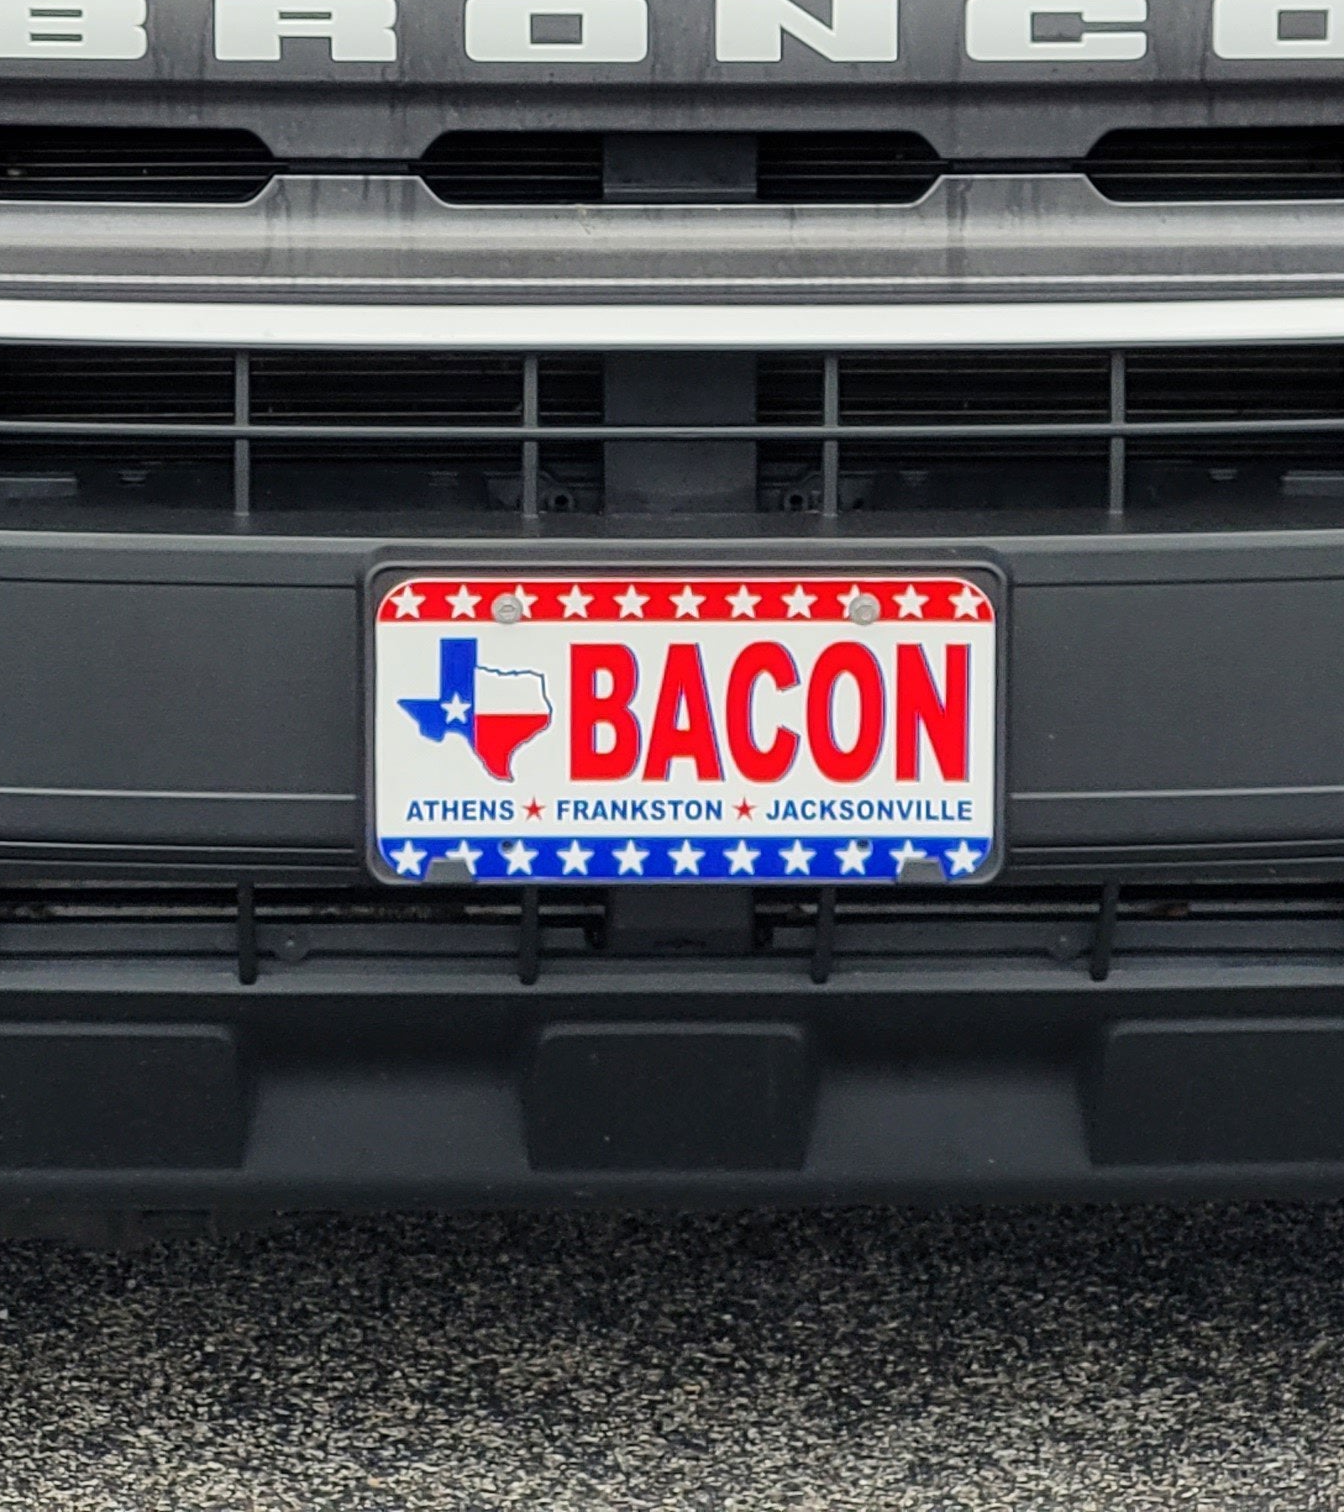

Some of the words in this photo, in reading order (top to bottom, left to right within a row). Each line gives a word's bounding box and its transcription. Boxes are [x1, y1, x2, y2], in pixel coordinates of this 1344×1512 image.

[568, 640, 971, 784] BACON
[405, 799, 515, 822] ATHENS
[555, 798, 723, 822] FRANKSTON
[766, 798, 973, 822] JACKSONVILLE
